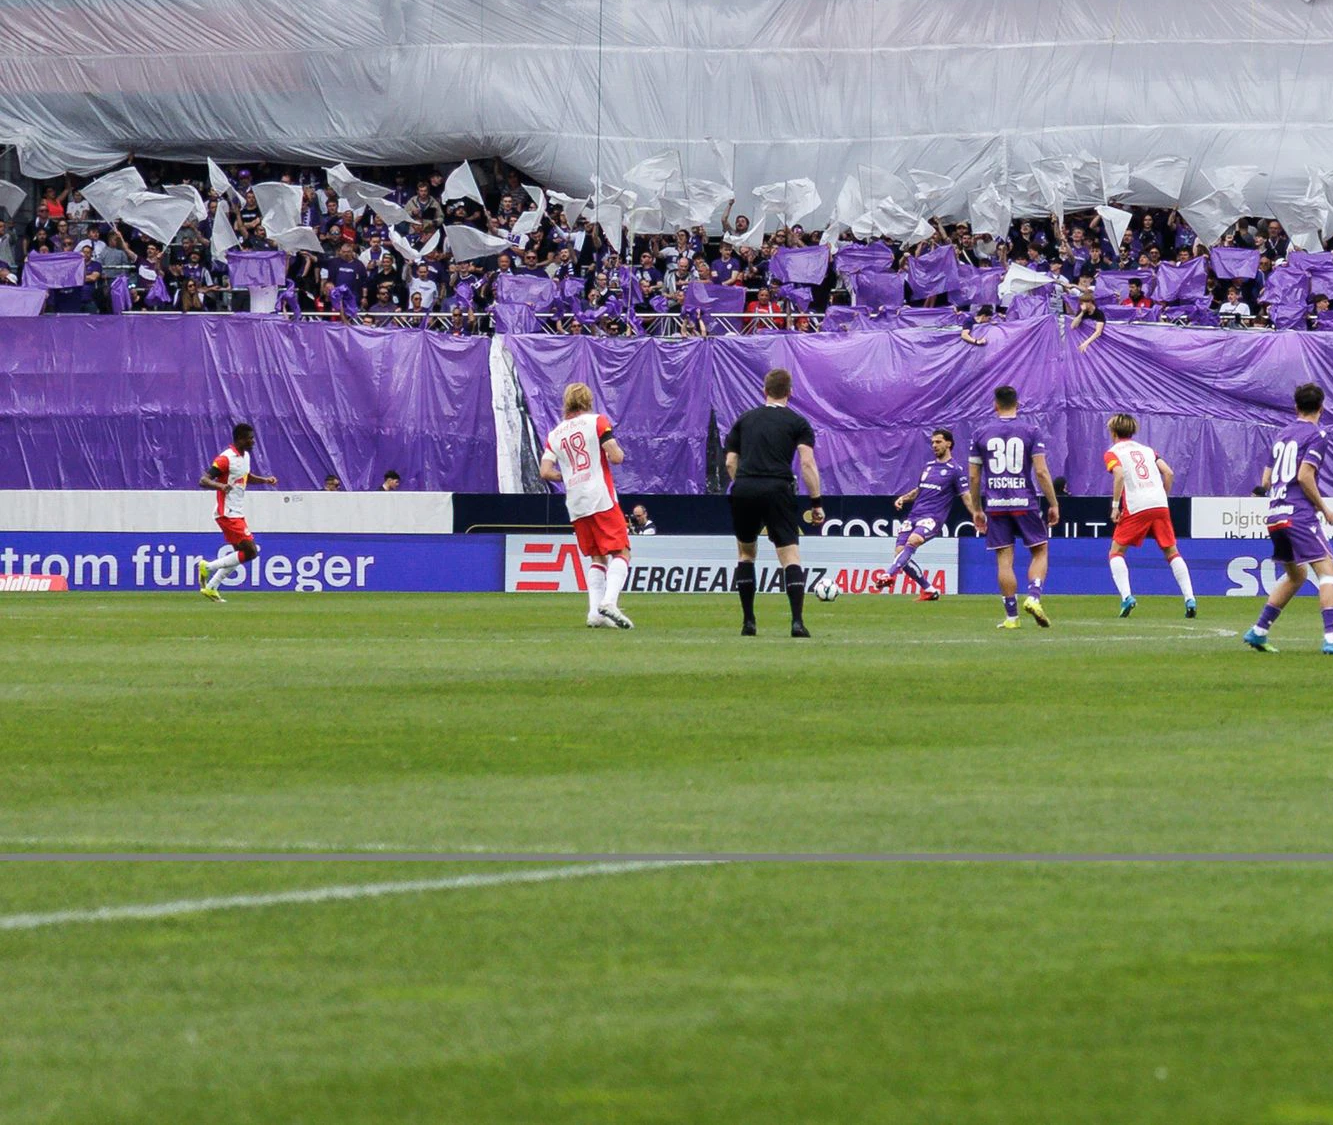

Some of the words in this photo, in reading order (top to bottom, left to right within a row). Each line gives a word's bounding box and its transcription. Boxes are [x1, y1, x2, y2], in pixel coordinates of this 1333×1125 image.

[560, 432, 590, 475] 18
[987, 437, 1025, 474] 30
[1130, 450, 1149, 479] 8
[1271, 440, 1298, 484] 20
[988, 477, 1026, 489] FISCHER
